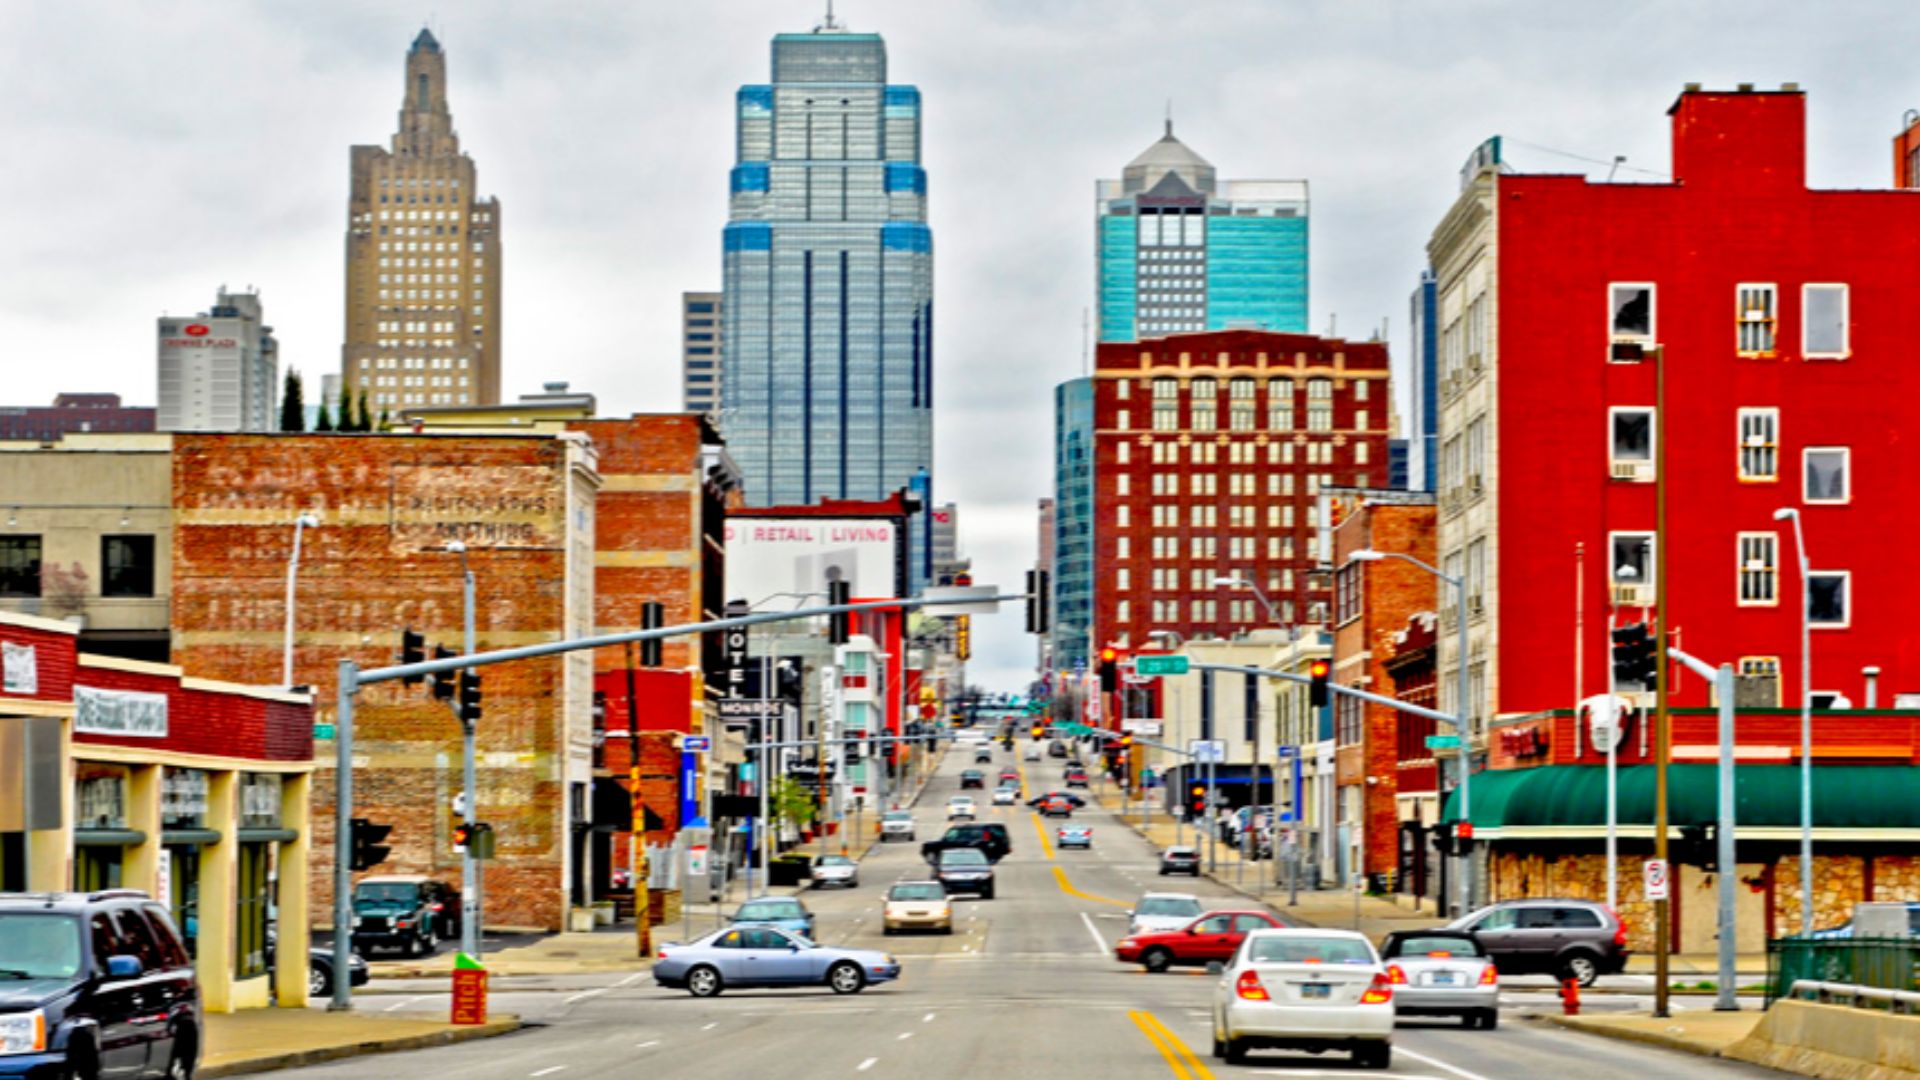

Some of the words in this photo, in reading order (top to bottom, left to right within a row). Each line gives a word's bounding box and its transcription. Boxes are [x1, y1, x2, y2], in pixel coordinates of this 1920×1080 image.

[754, 526, 814, 542] RETAIL
[831, 526, 889, 542] LIVING
[728, 624, 745, 699] OTEL
[455, 974, 477, 1023] Pitch
